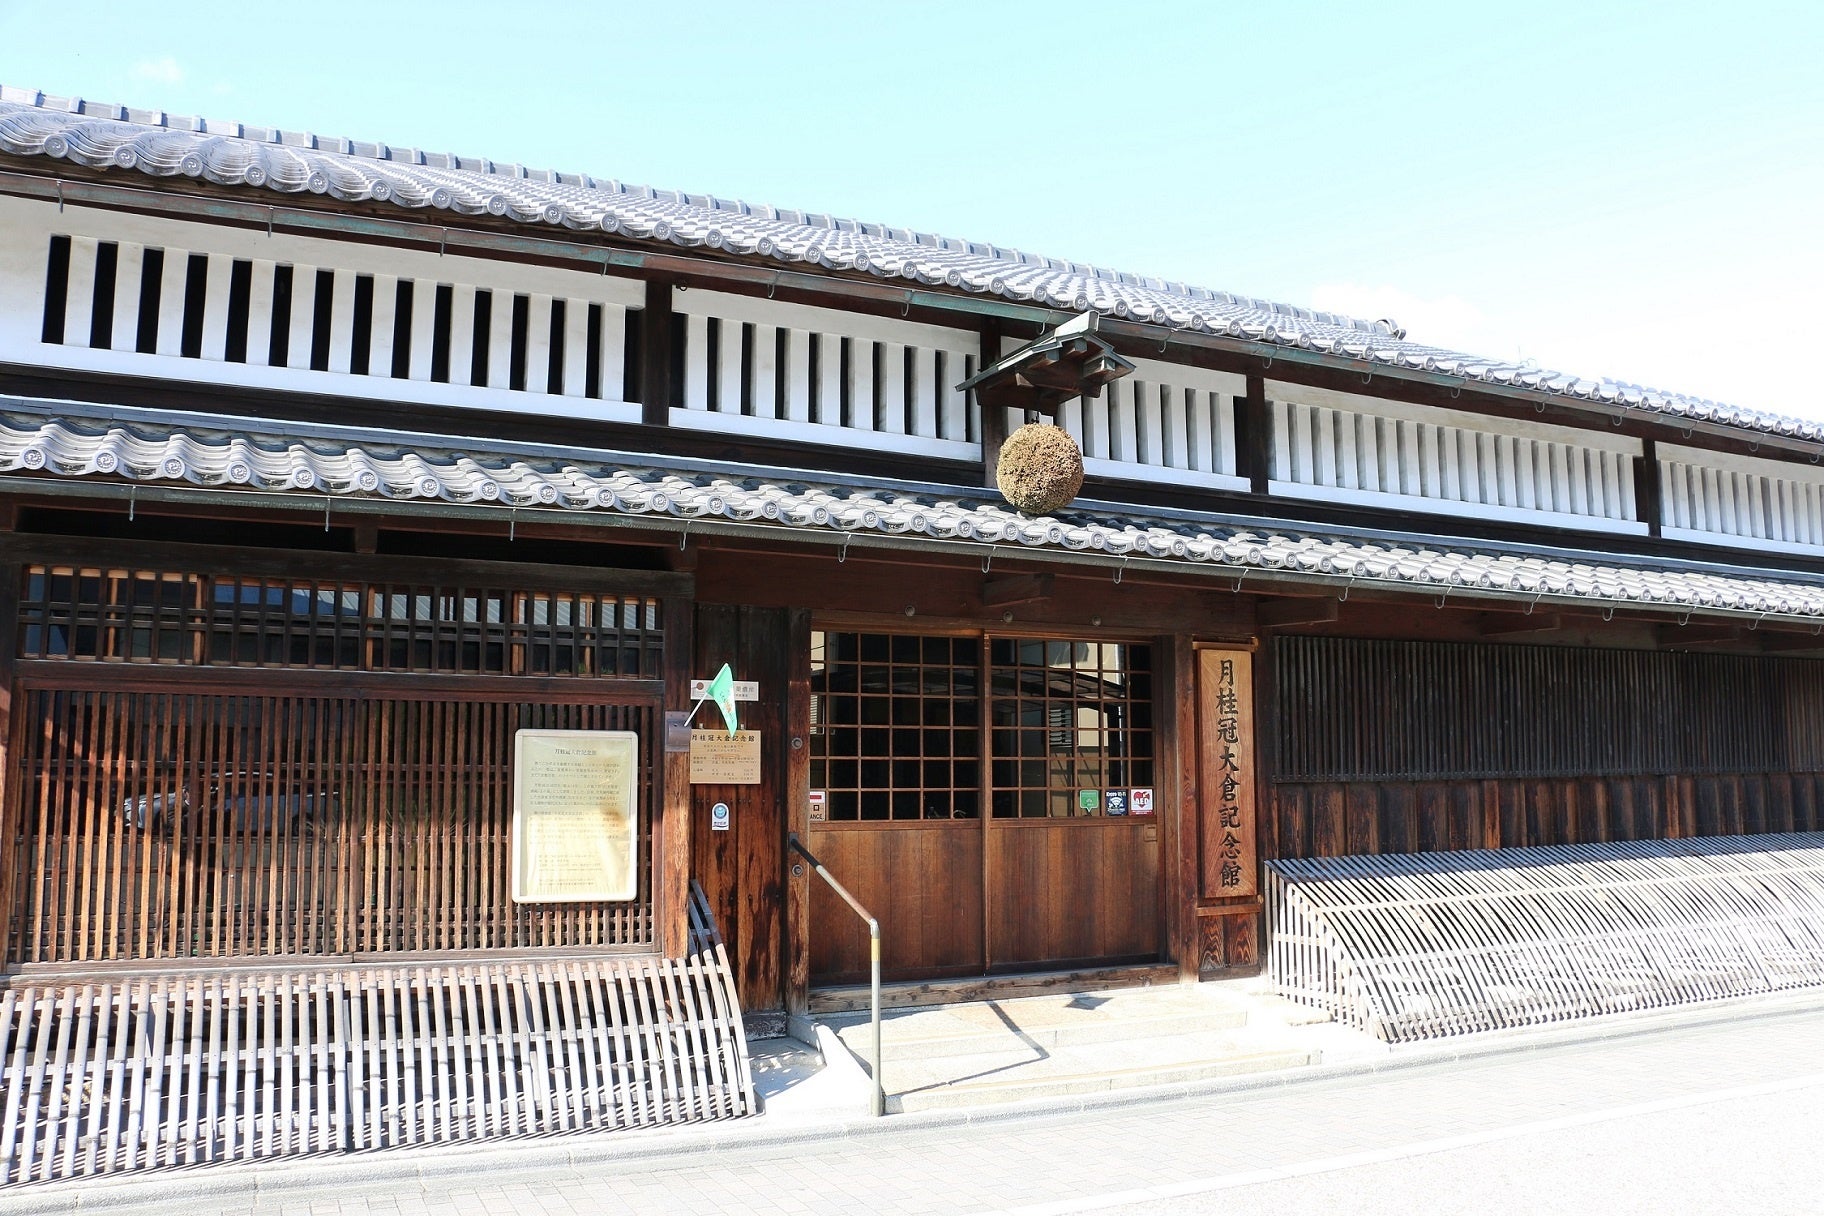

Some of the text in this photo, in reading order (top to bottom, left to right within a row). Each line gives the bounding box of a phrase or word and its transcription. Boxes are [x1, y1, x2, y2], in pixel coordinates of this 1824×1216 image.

[691, 734, 755, 742] 月桂冠大倉記念館
[1215, 659, 1241, 888] 月桂冠大倉記念館
